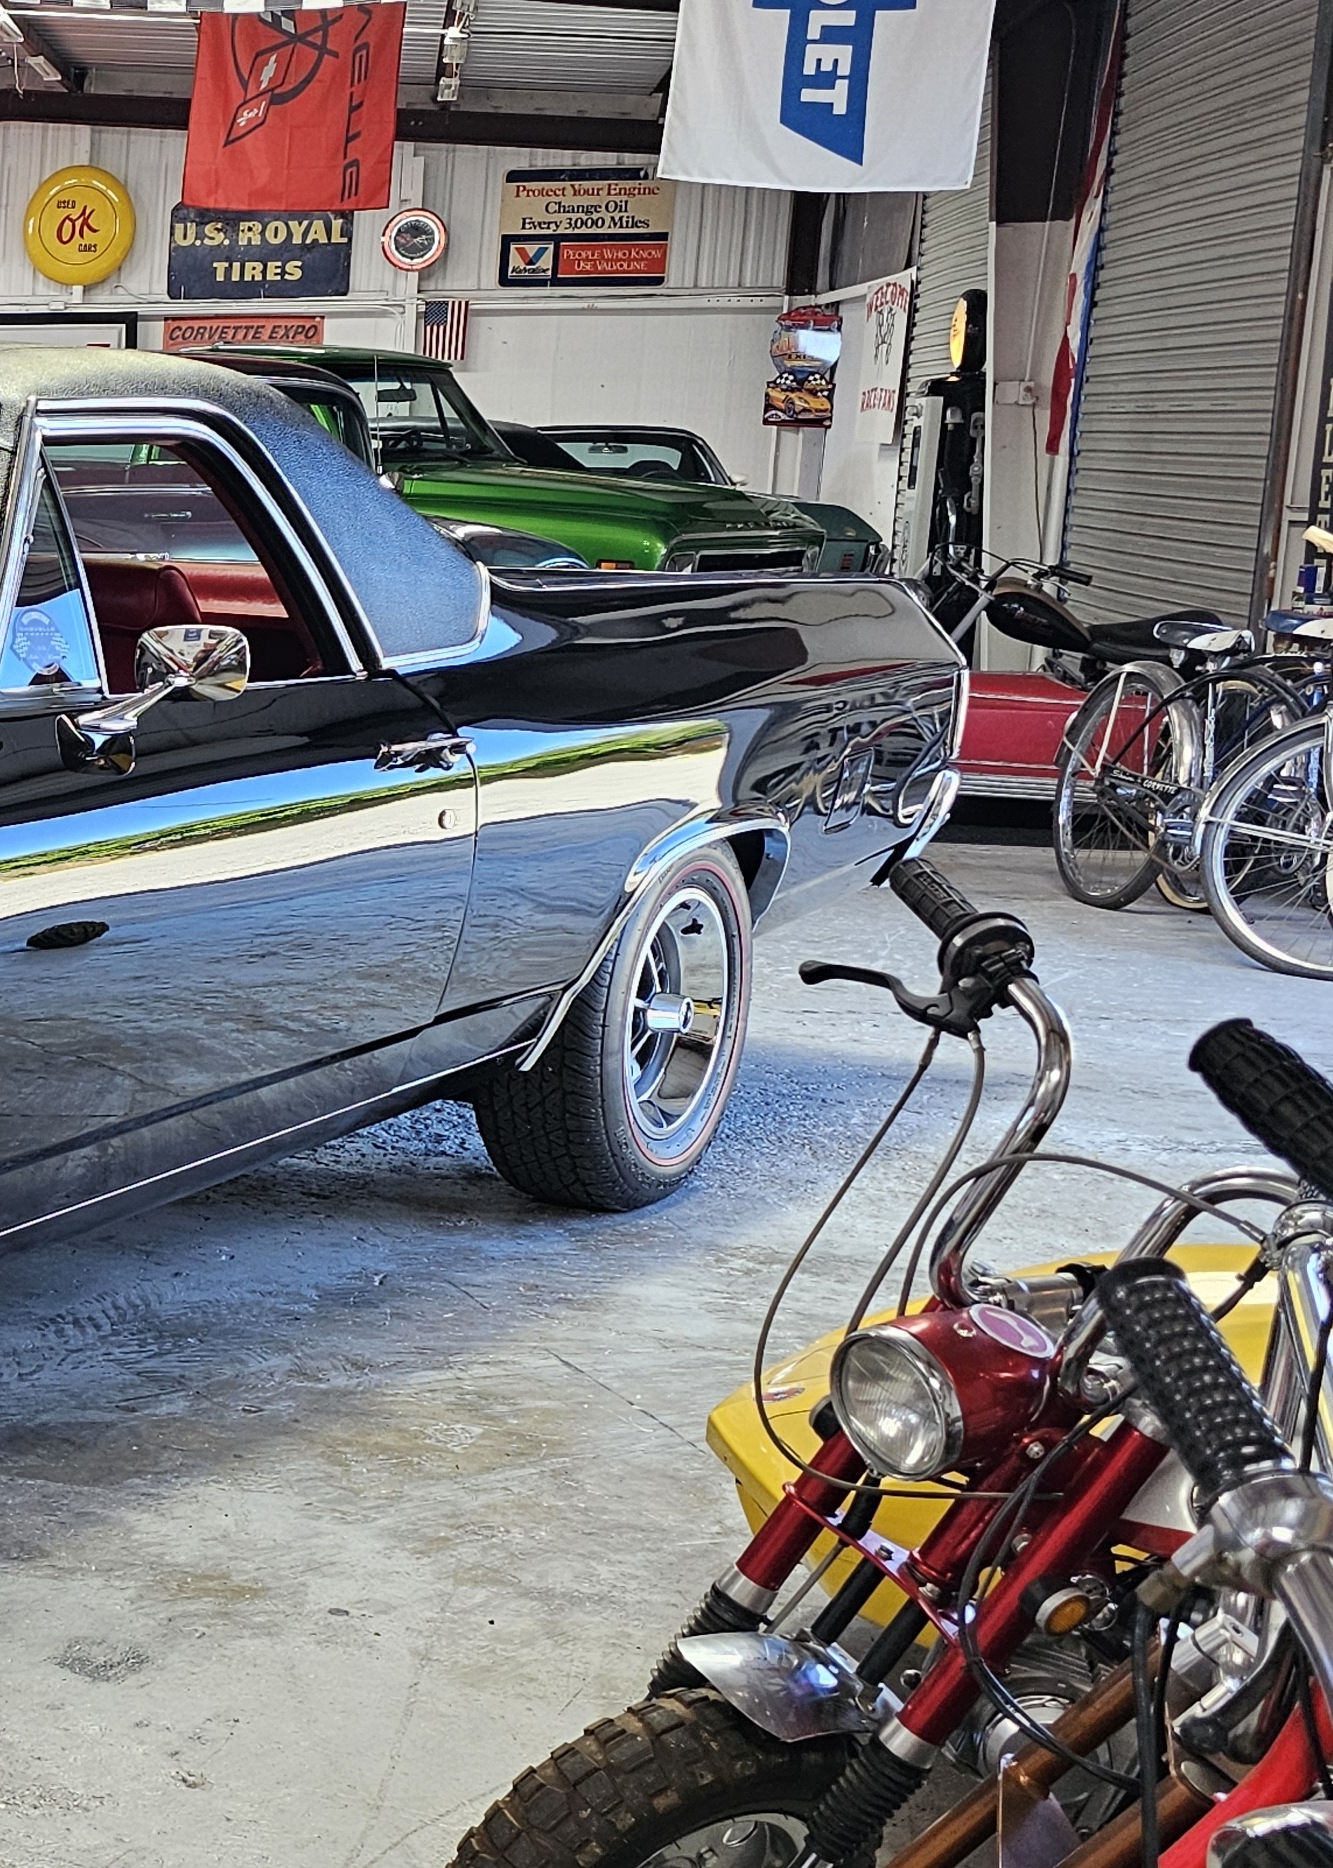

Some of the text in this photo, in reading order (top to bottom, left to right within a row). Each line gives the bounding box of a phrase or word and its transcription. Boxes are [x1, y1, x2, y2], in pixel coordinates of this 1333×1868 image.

[800, 0, 856, 115] LET
[514, 183, 660, 198] Protect Your Engine
[56, 199, 76, 209] USED
[544, 199, 629, 216] Change Oil
[56, 205, 100, 245] OK
[173, 219, 348, 246] U.S. ROYAL
[521, 216, 650, 232] Every 3,000 Miles
[78, 243, 98, 253] CARS
[212, 261, 303, 281] TIRES
[866, 282, 909, 321] WELCOME
[168, 323, 320, 341] CORVETTE EXPO
